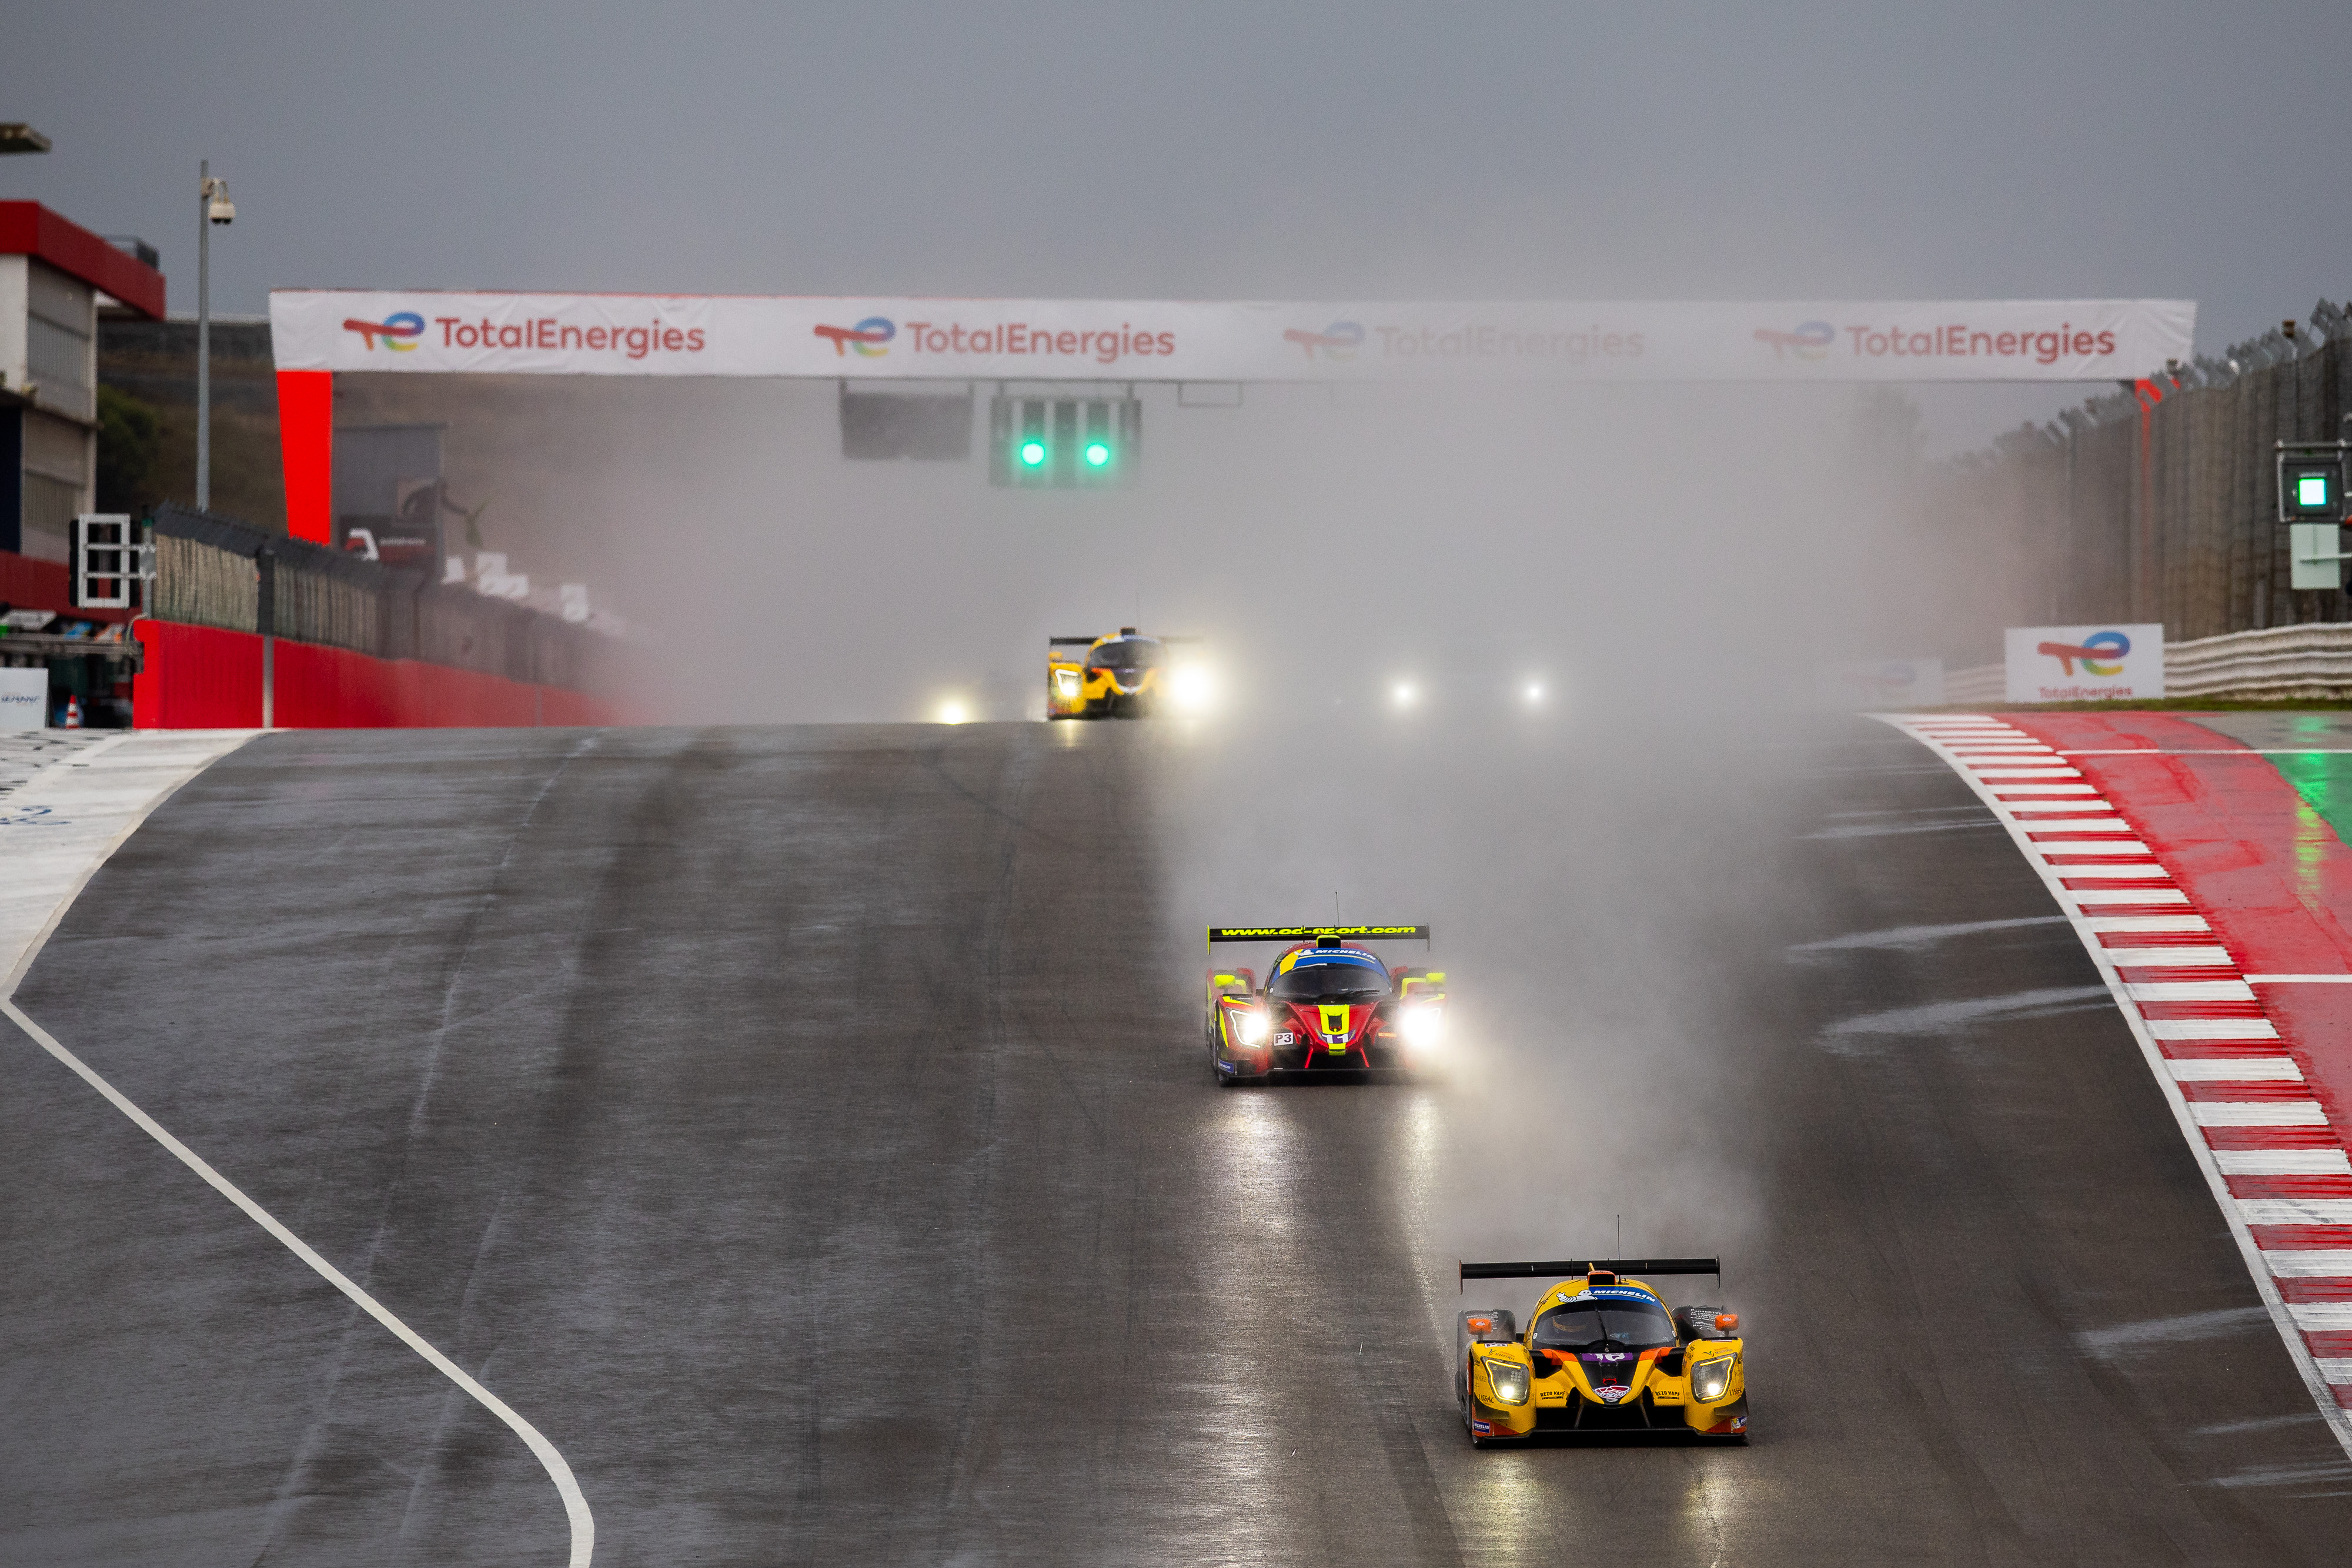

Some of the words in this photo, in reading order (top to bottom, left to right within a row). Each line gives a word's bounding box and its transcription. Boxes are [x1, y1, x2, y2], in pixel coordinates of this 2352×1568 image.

[436, 317, 705, 360] TotalEnergies
[906, 321, 1175, 363] TotalEnergies
[1845, 323, 2116, 365] TotalEnergies
[1374, 325, 1645, 365] TotalEnergies
[2038, 685, 2133, 700] TotalEnergies
[1221, 925, 1416, 935] www.cd-sport.com
[1315, 950, 1377, 961] MICHELIN
[1275, 1034, 1292, 1044] P3
[1322, 1034, 1349, 1044] 11
[1593, 1290, 1656, 1302] MICHELIN
[1478, 1393, 1494, 1403] LISSAC
